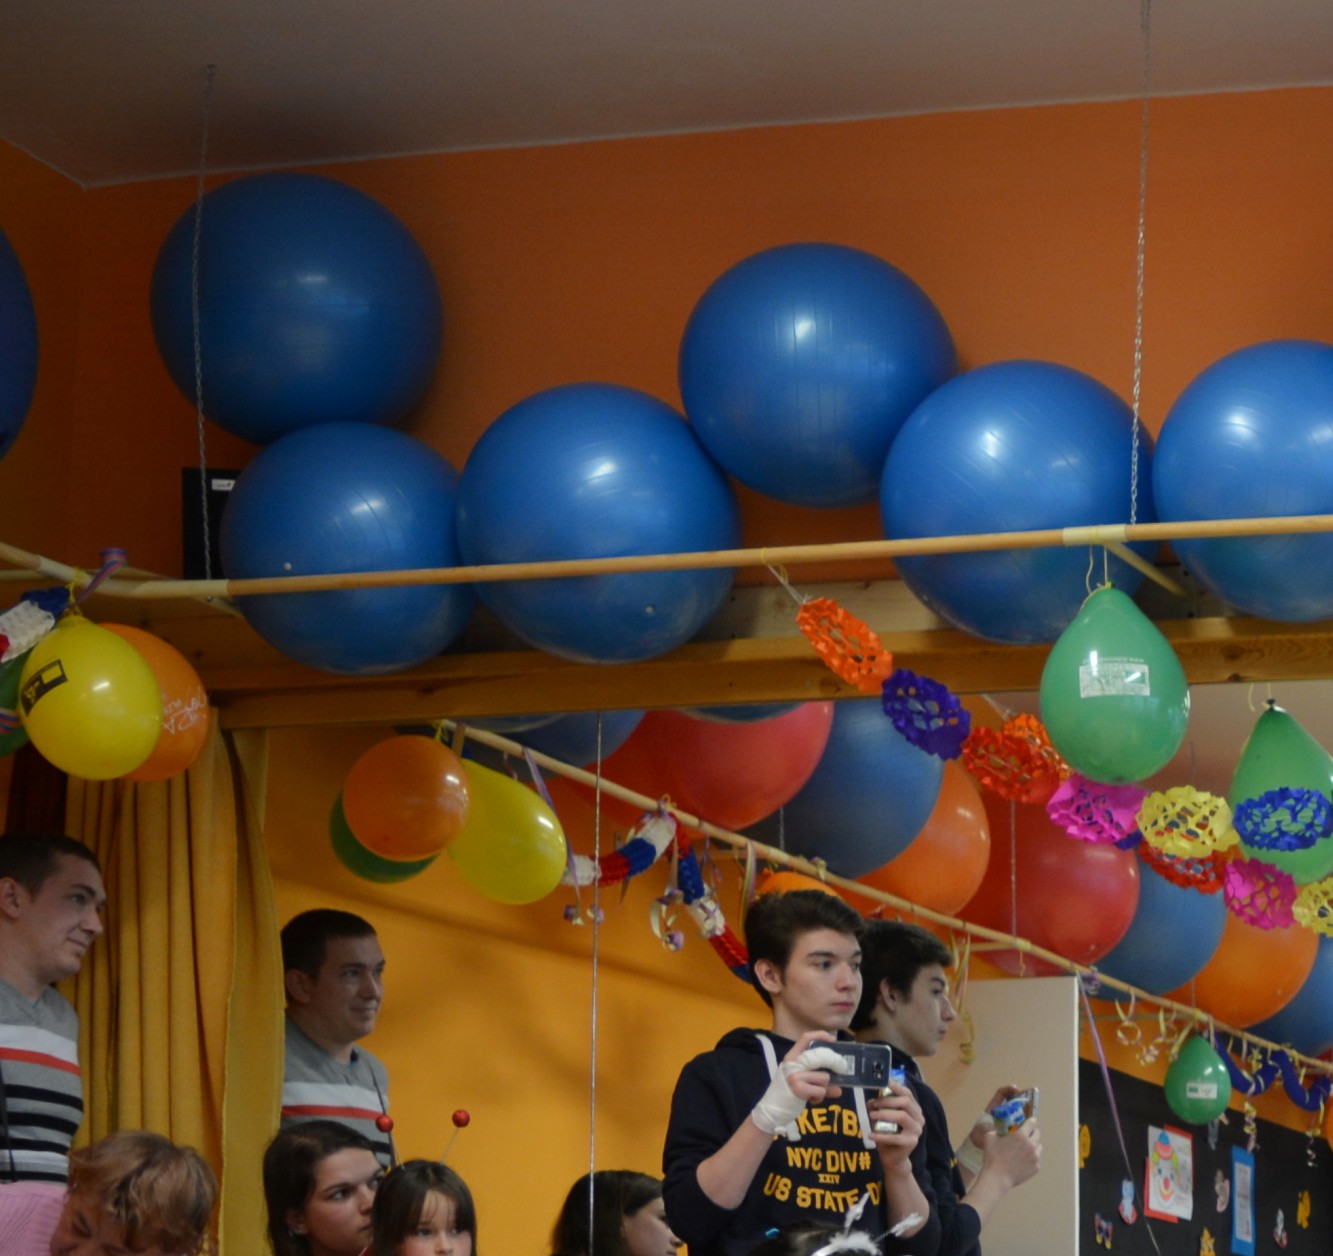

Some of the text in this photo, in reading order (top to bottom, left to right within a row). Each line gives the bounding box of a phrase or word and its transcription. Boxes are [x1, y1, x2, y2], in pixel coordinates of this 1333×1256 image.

[786, 1146, 871, 1173] NYC DIV#
[818, 1173, 840, 1184] XXIV
[763, 1172, 792, 1202] US
[796, 1185, 859, 1213] STATE
